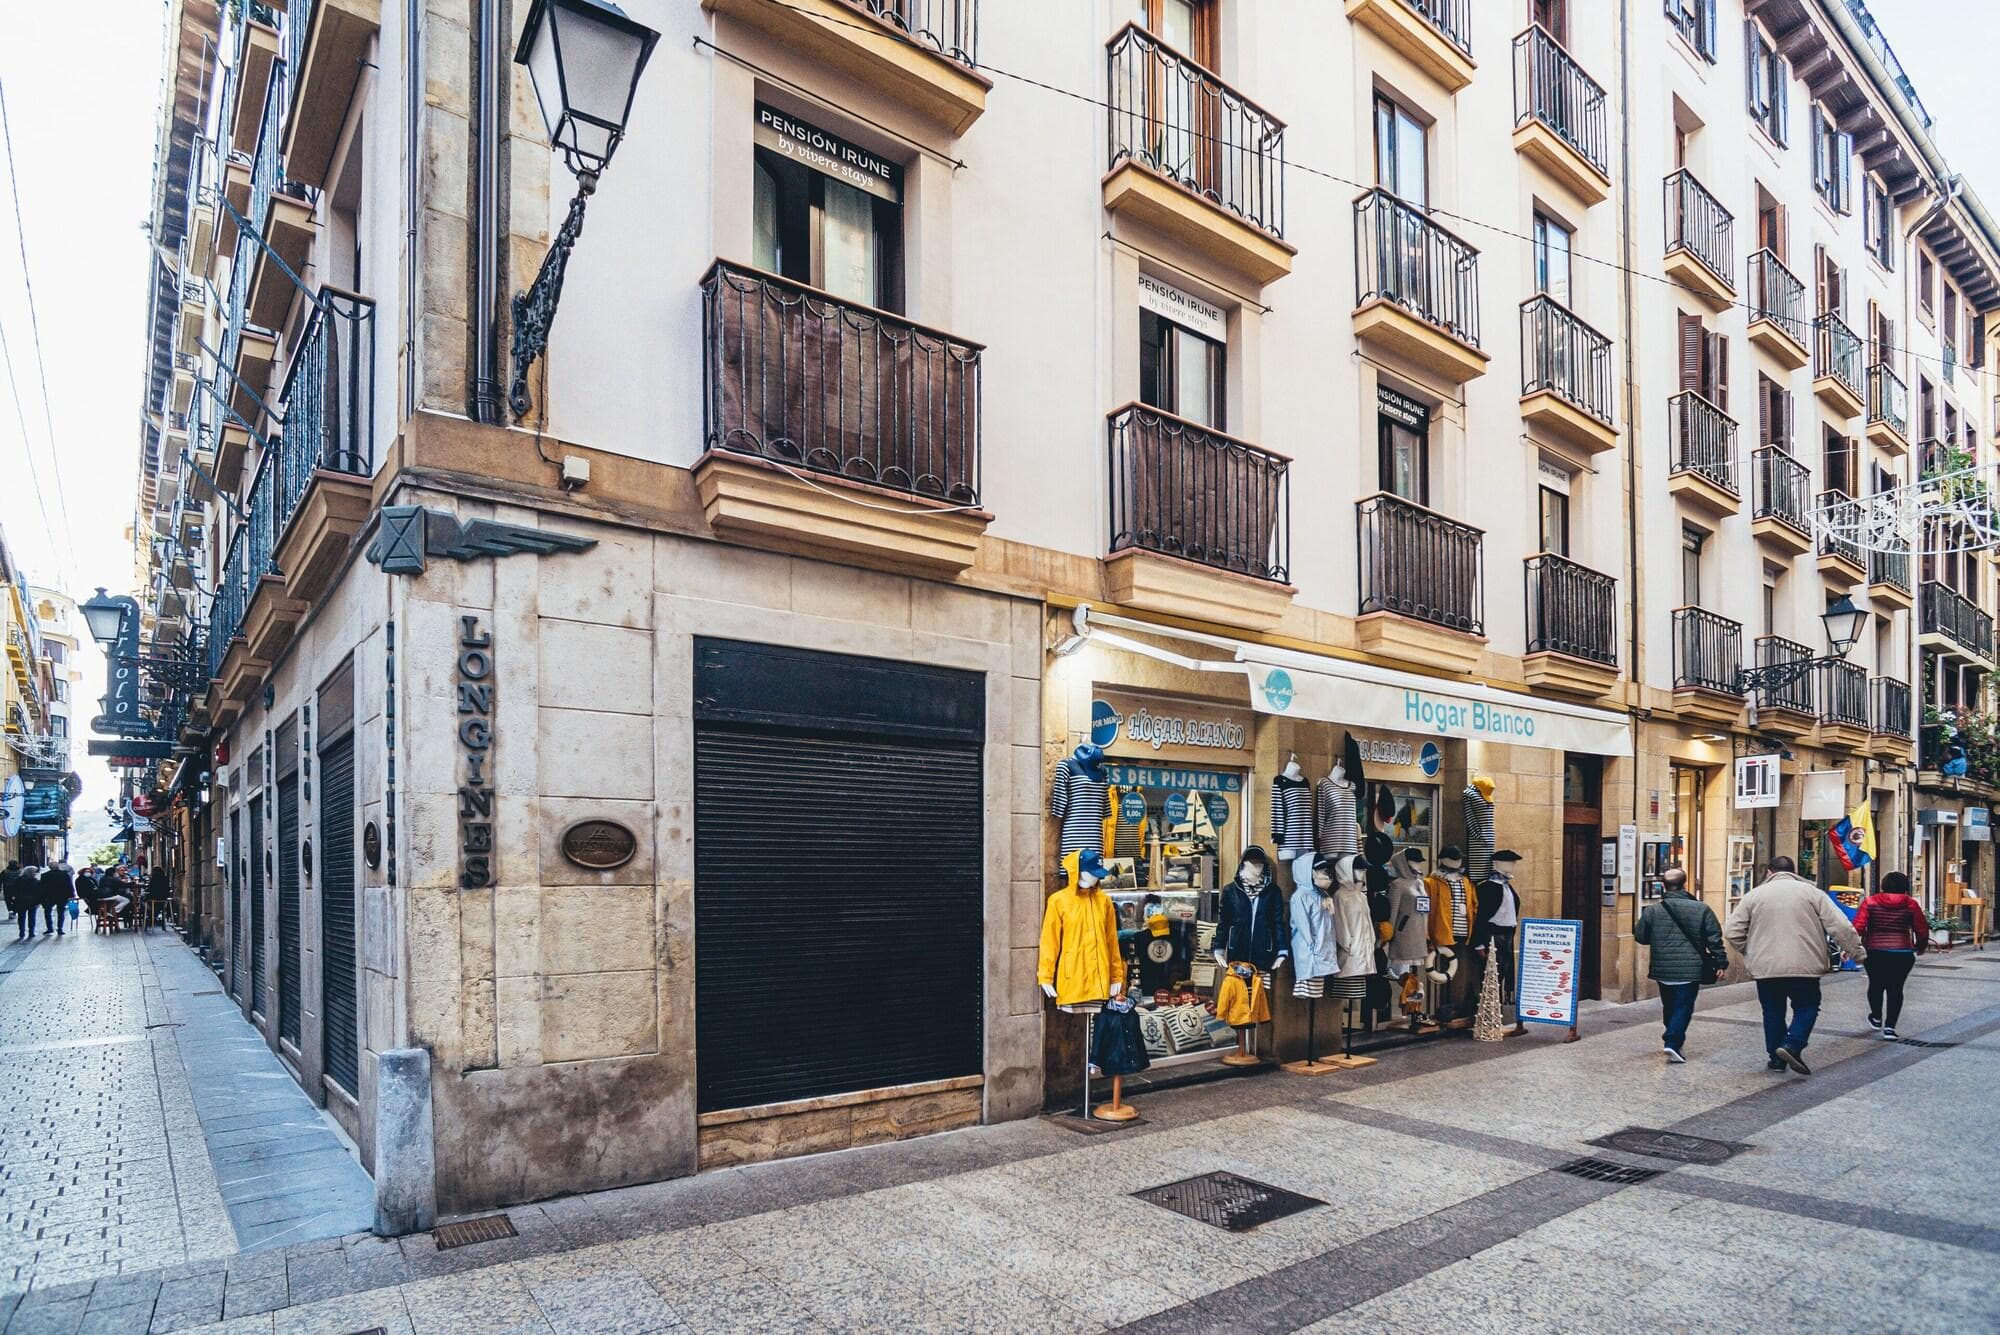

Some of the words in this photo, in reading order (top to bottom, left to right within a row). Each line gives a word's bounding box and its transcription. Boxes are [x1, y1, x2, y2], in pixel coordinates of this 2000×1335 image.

[761, 110, 837, 154] PENSIÓN
[842, 147, 890, 179] IRUNE
[778, 134, 795, 153] by
[798, 145, 838, 172] vivere
[841, 165, 874, 188] stays
[1139, 277, 1185, 306] PENSIÓN
[1187, 298, 1218, 321] IRUNE
[1403, 399, 1425, 417] IRUNE
[1128, 708, 1186, 750] HOGAR
[1186, 718, 1245, 749] BLANCO
[1405, 688, 1467, 732] Hogar
[1472, 701, 1535, 737] Blanco
[458, 615, 495, 890] LONGINES
[1127, 768, 1155, 786] DEL
[1161, 771, 1219, 790] PIJAMA
